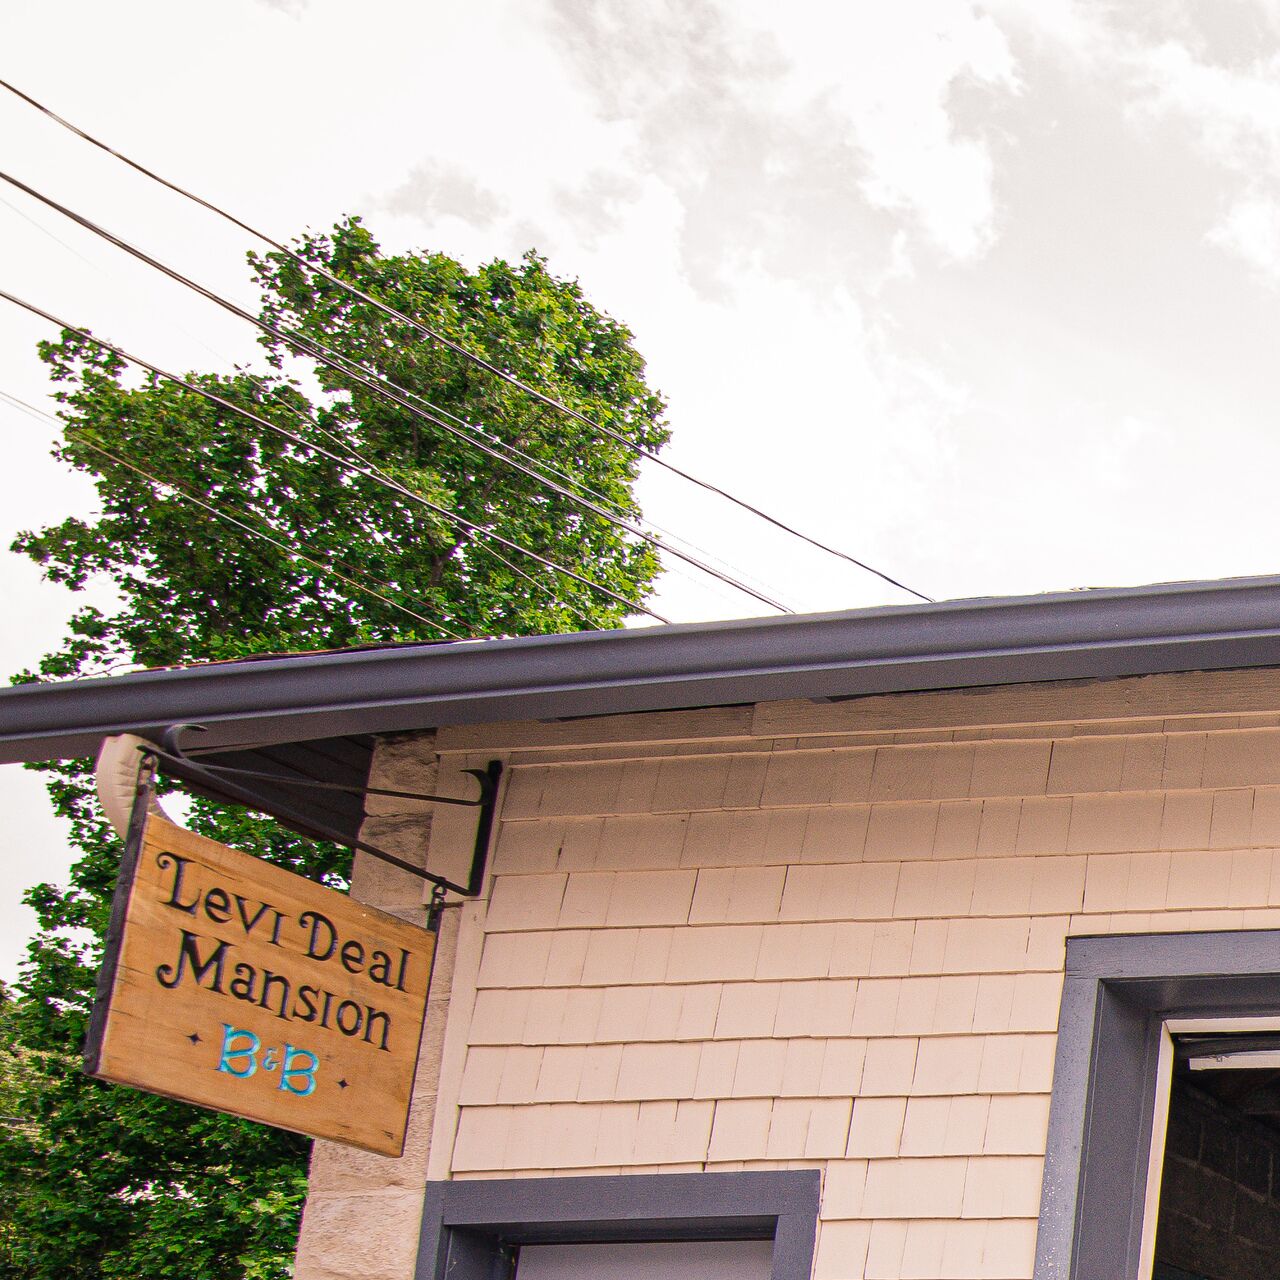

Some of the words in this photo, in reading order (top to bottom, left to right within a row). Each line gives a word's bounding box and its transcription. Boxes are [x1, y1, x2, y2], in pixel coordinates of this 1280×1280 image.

[156, 928, 392, 1053] Mansion
[299, 910, 411, 993] Deal
[215, 1022, 321, 1098] B&B
